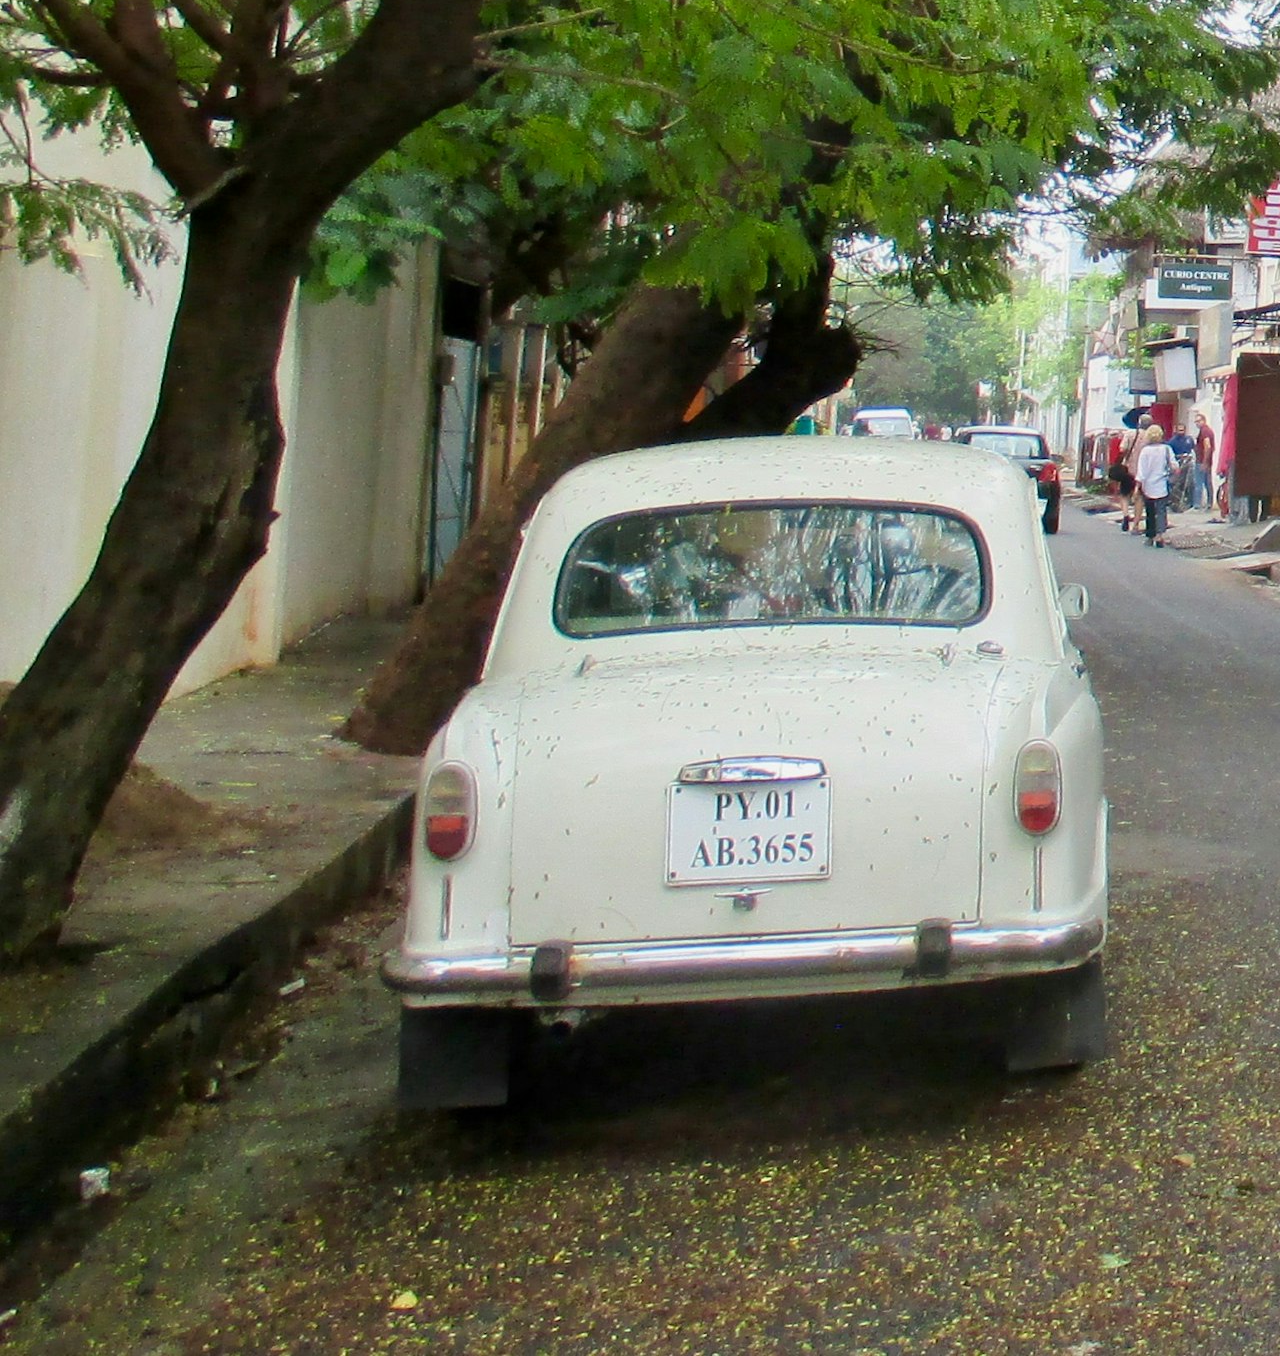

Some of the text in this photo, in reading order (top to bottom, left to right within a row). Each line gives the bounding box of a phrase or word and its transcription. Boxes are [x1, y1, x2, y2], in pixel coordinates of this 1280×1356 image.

[1164, 270, 1230, 281] CURIO CENTRE
[1180, 283, 1213, 294] Antiques
[714, 789, 796, 822] PY.01
[690, 833, 814, 868] AB.3655
